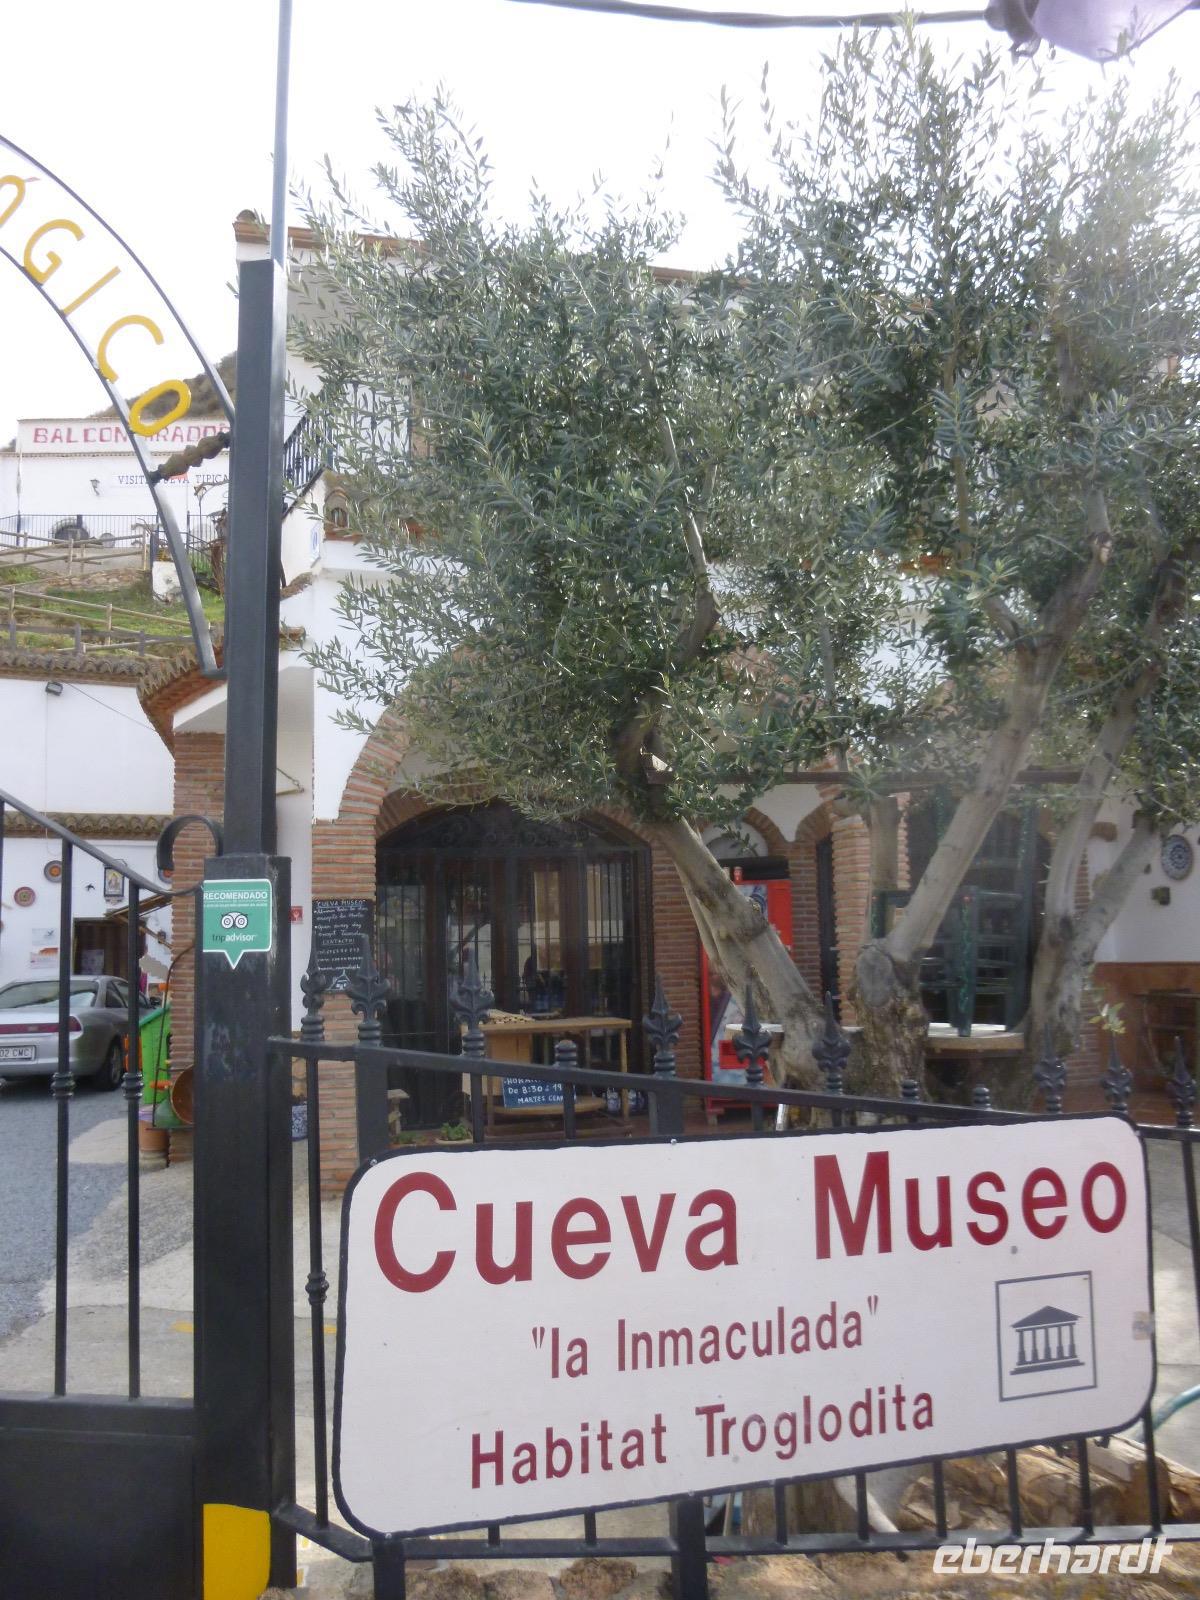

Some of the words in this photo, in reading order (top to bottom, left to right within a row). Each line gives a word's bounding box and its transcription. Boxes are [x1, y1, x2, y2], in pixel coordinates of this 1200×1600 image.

[33, 426, 128, 444] BALCON
[203, 891, 268, 900] RECOMENDADO
[212, 932, 255, 943] tripadvisor
[517, 1095, 545, 1104] MARTES
[374, 1171, 739, 1293] Cueva
[813, 1150, 1128, 1260] Museo
[531, 1325, 589, 1379] "la
[617, 1294, 879, 1372] Inmaculada"
[471, 1412, 667, 1489] Habitat
[695, 1384, 934, 1460] Troglodita
